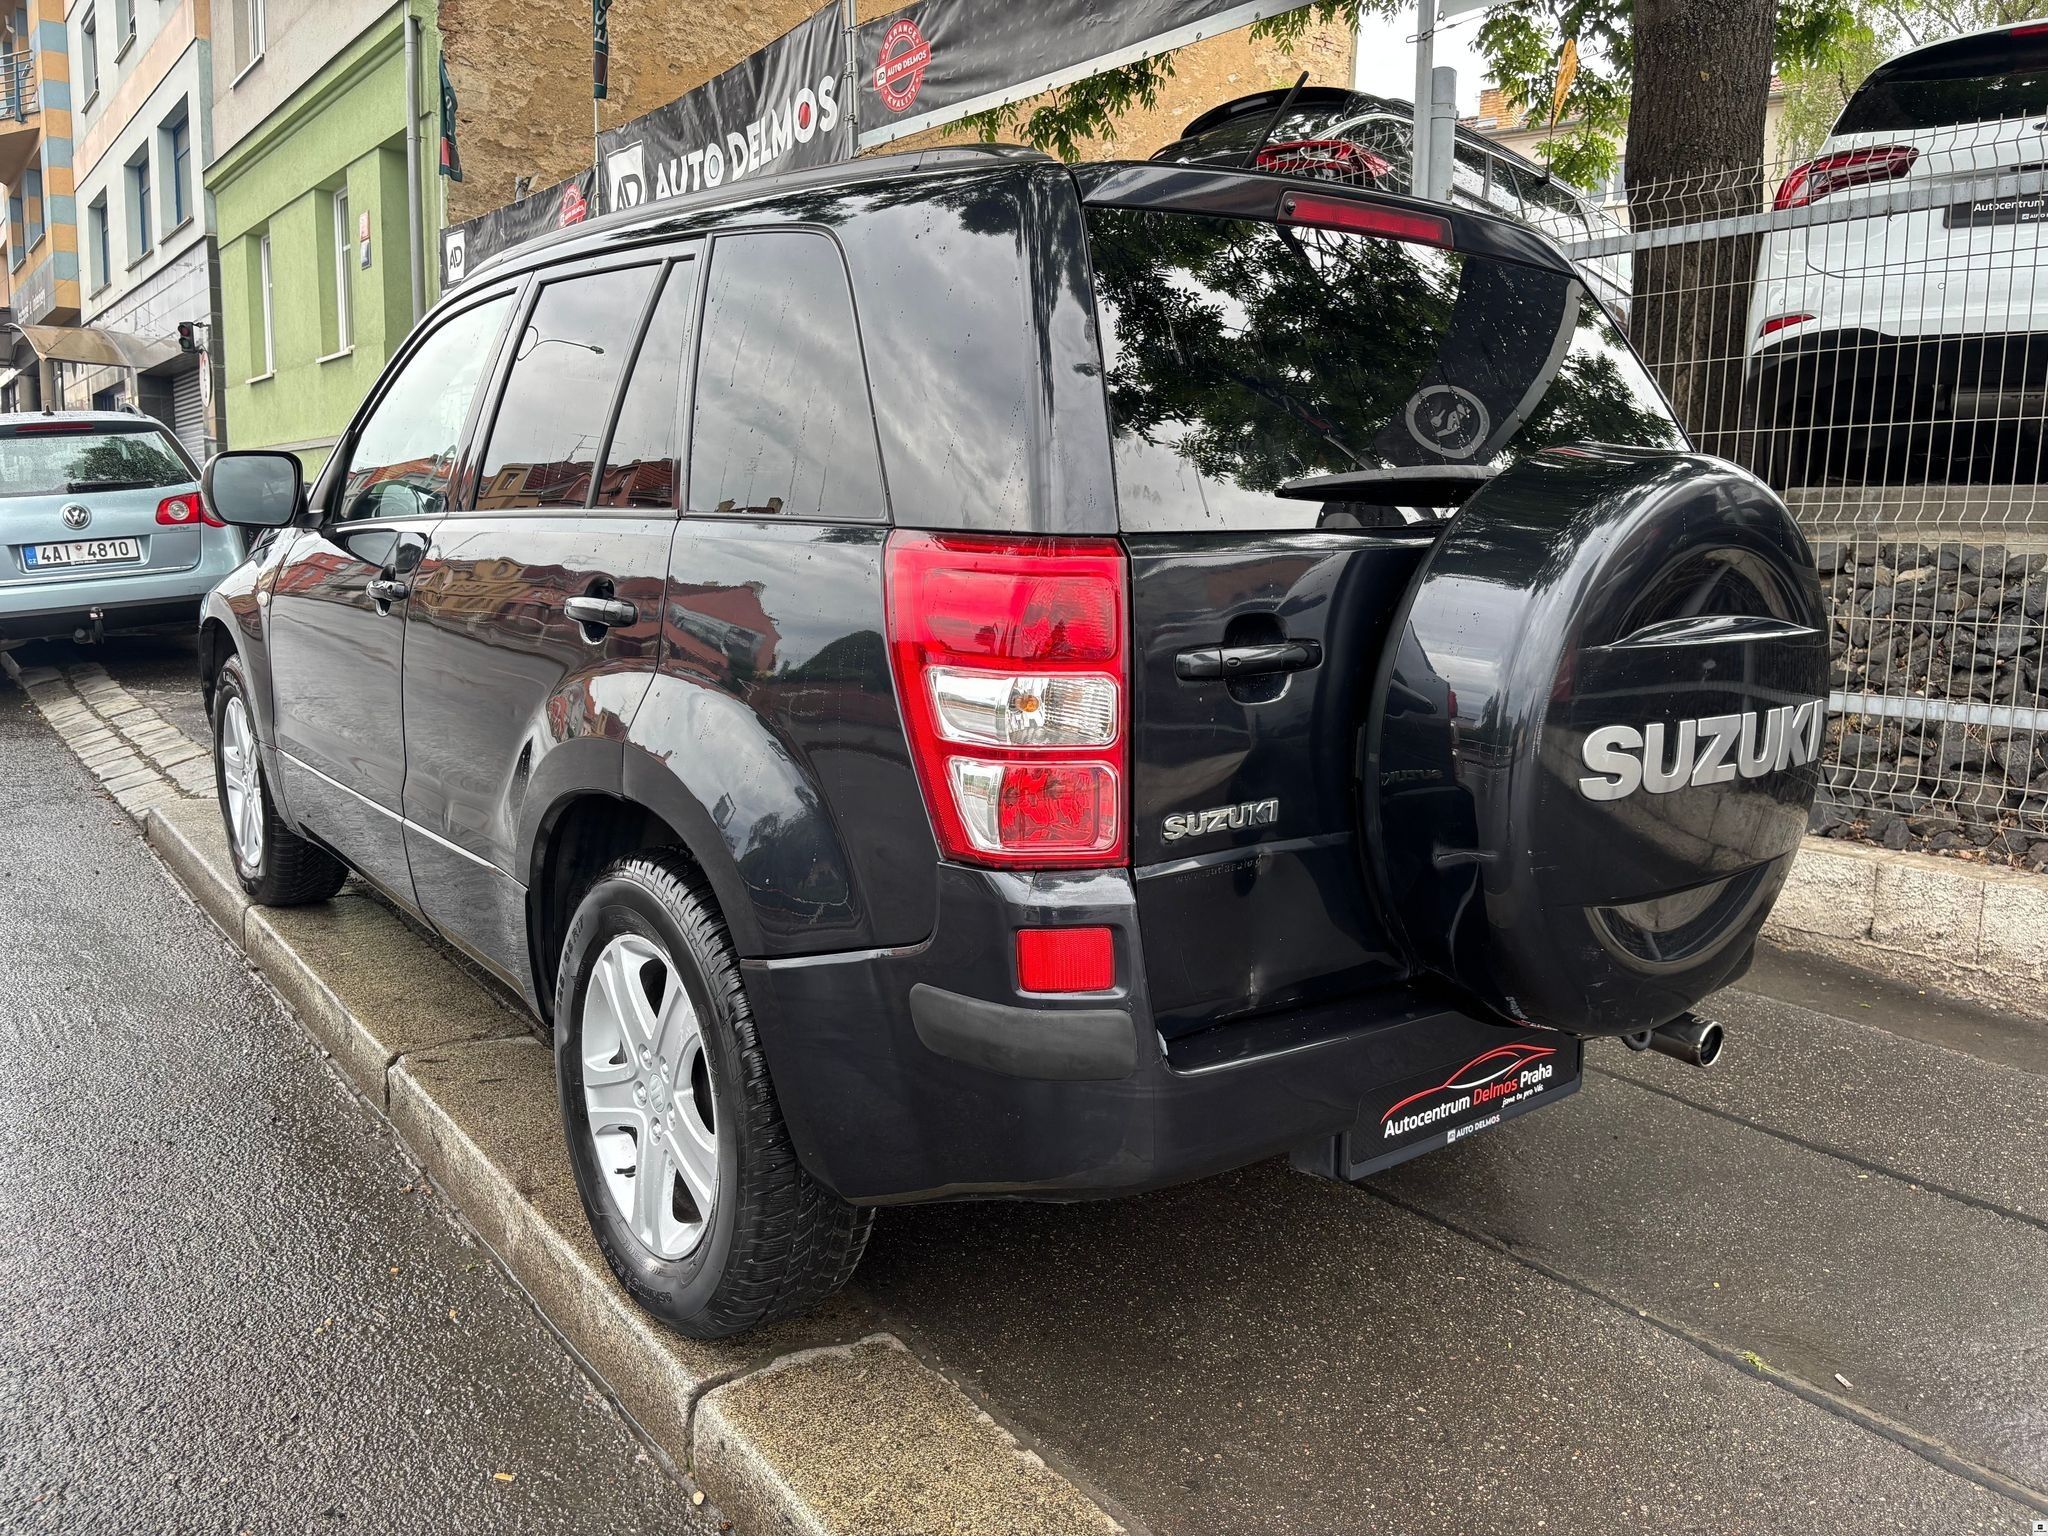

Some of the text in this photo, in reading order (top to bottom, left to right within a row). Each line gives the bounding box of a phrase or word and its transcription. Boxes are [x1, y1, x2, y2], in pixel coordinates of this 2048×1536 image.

[887, 62, 903, 77] AUTO
[902, 50, 927, 69] DELMOS
[887, 85, 916, 107] KVALITY
[655, 142, 725, 200] AUTO
[726, 75, 839, 182] DELMOS
[1973, 199, 2045, 212] Autocentrum
[41, 545, 72, 562] 4AI
[87, 541, 130, 558] 4810
[1578, 699, 1824, 801] SUZUKI
[1162, 798, 1279, 842] SUZUKI
[1383, 1094, 1470, 1139] Autocentrum
[1473, 1077, 1518, 1106] Delmos
[1519, 1063, 1553, 1088] Praha
[1456, 1123, 1474, 1138] AUTO
[1475, 1114, 1500, 1131] DELMOS
